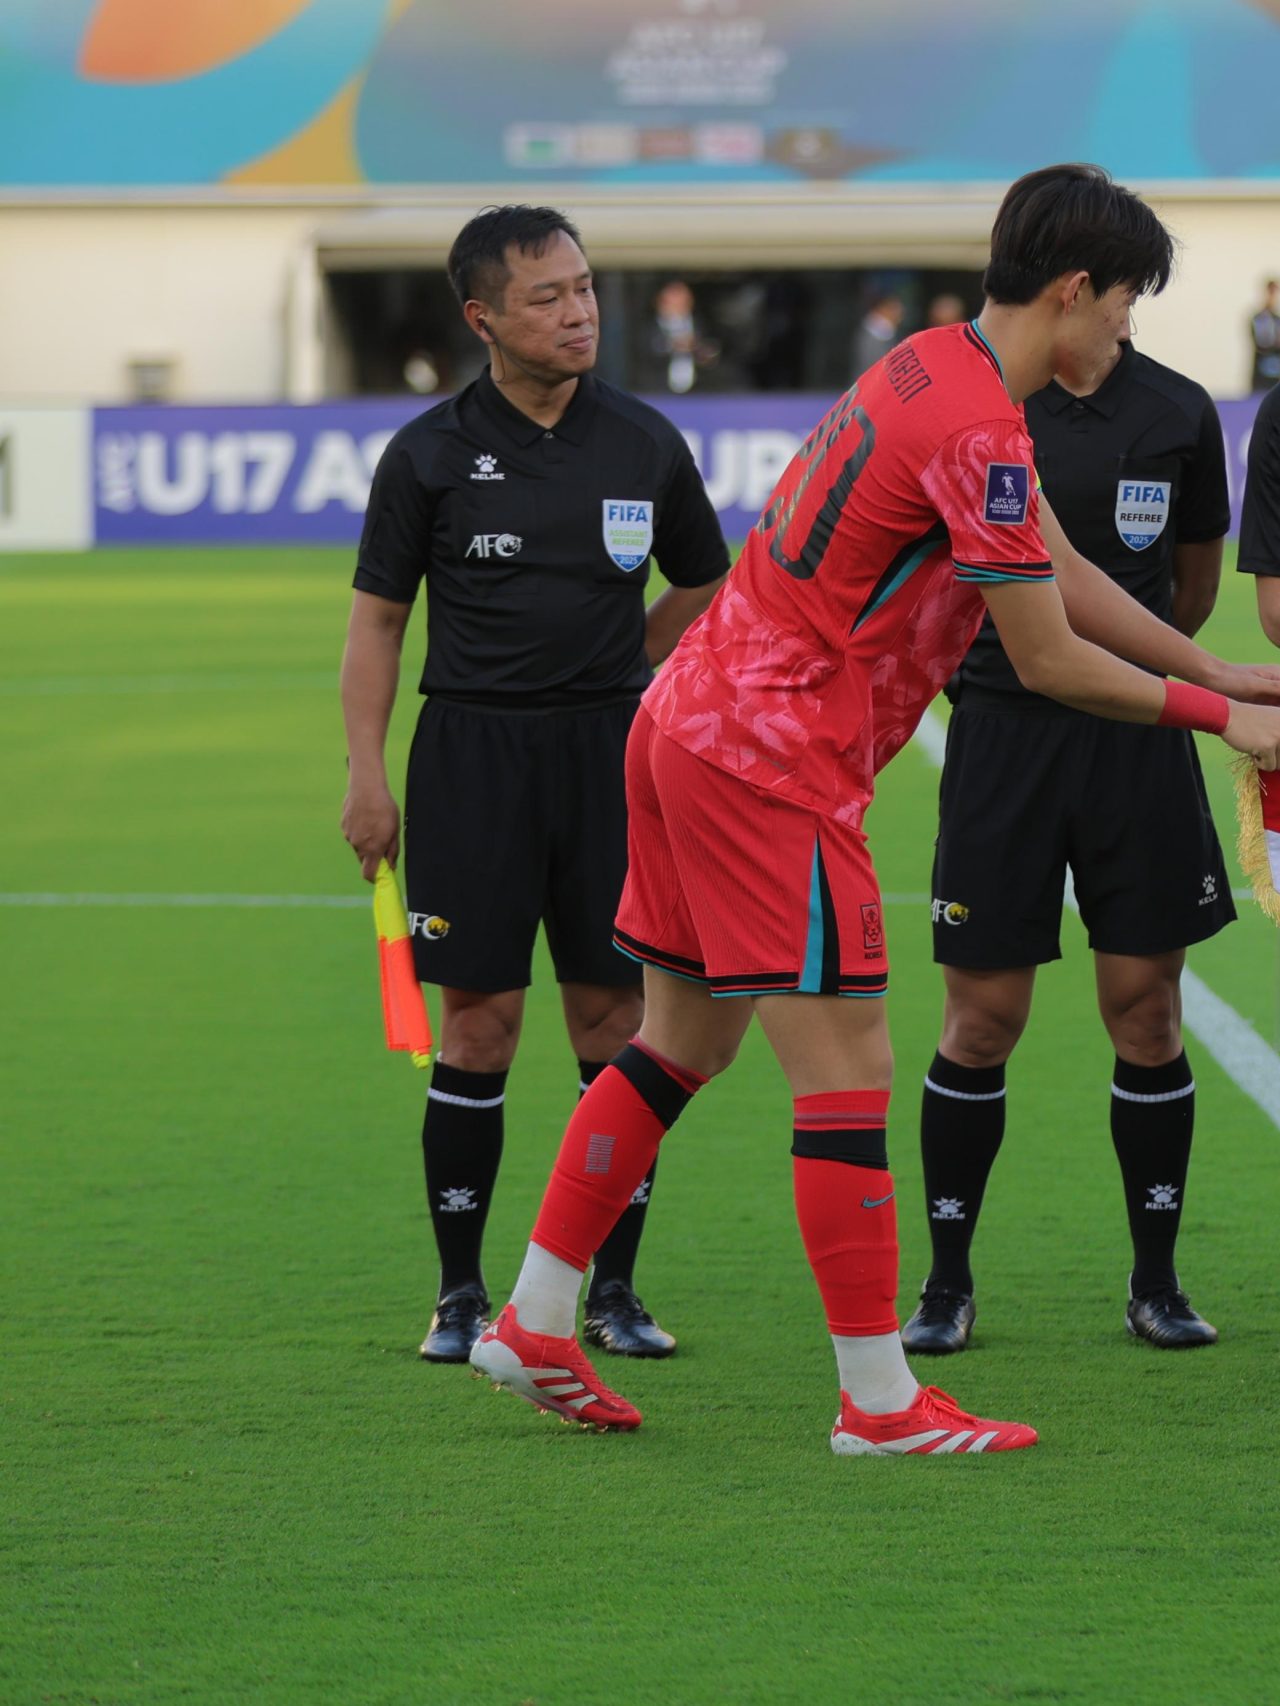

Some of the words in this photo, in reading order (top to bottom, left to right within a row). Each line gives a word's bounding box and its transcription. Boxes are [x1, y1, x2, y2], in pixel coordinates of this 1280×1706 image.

[135, 430, 297, 516] U17
[1122, 485, 1165, 504] FIFA
[608, 504, 648, 522] FIFA
[1120, 512, 1163, 523] REFEREE
[465, 533, 522, 558] AFC
[1129, 535, 1149, 544] 2025
[620, 555, 638, 565] 2025
[408, 911, 450, 940] FC
[439, 1203, 478, 1212] KELME
[1145, 1202, 1178, 1210] KELME
